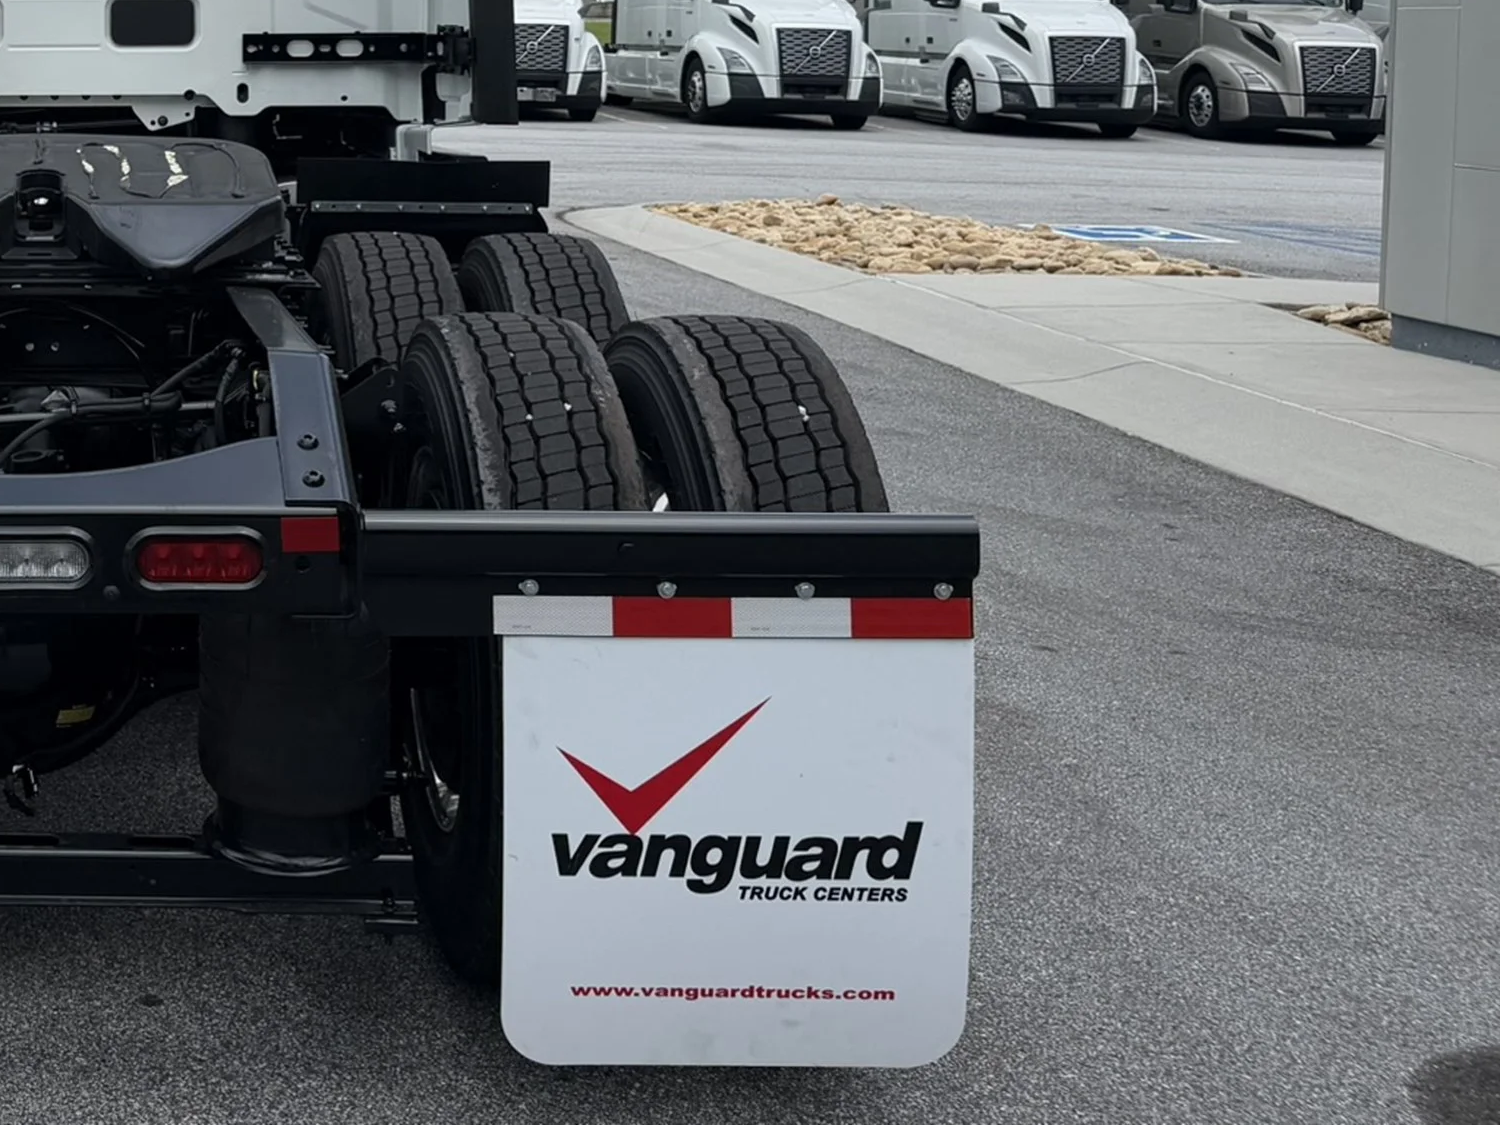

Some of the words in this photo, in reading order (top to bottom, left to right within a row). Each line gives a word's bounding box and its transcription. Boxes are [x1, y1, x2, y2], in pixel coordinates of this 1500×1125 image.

[551, 821, 924, 894] vanguard
[738, 886, 808, 901] TRUCK
[813, 886, 909, 902] CENTERS
[570, 985, 896, 1001] www.vanguardtrucks.com
